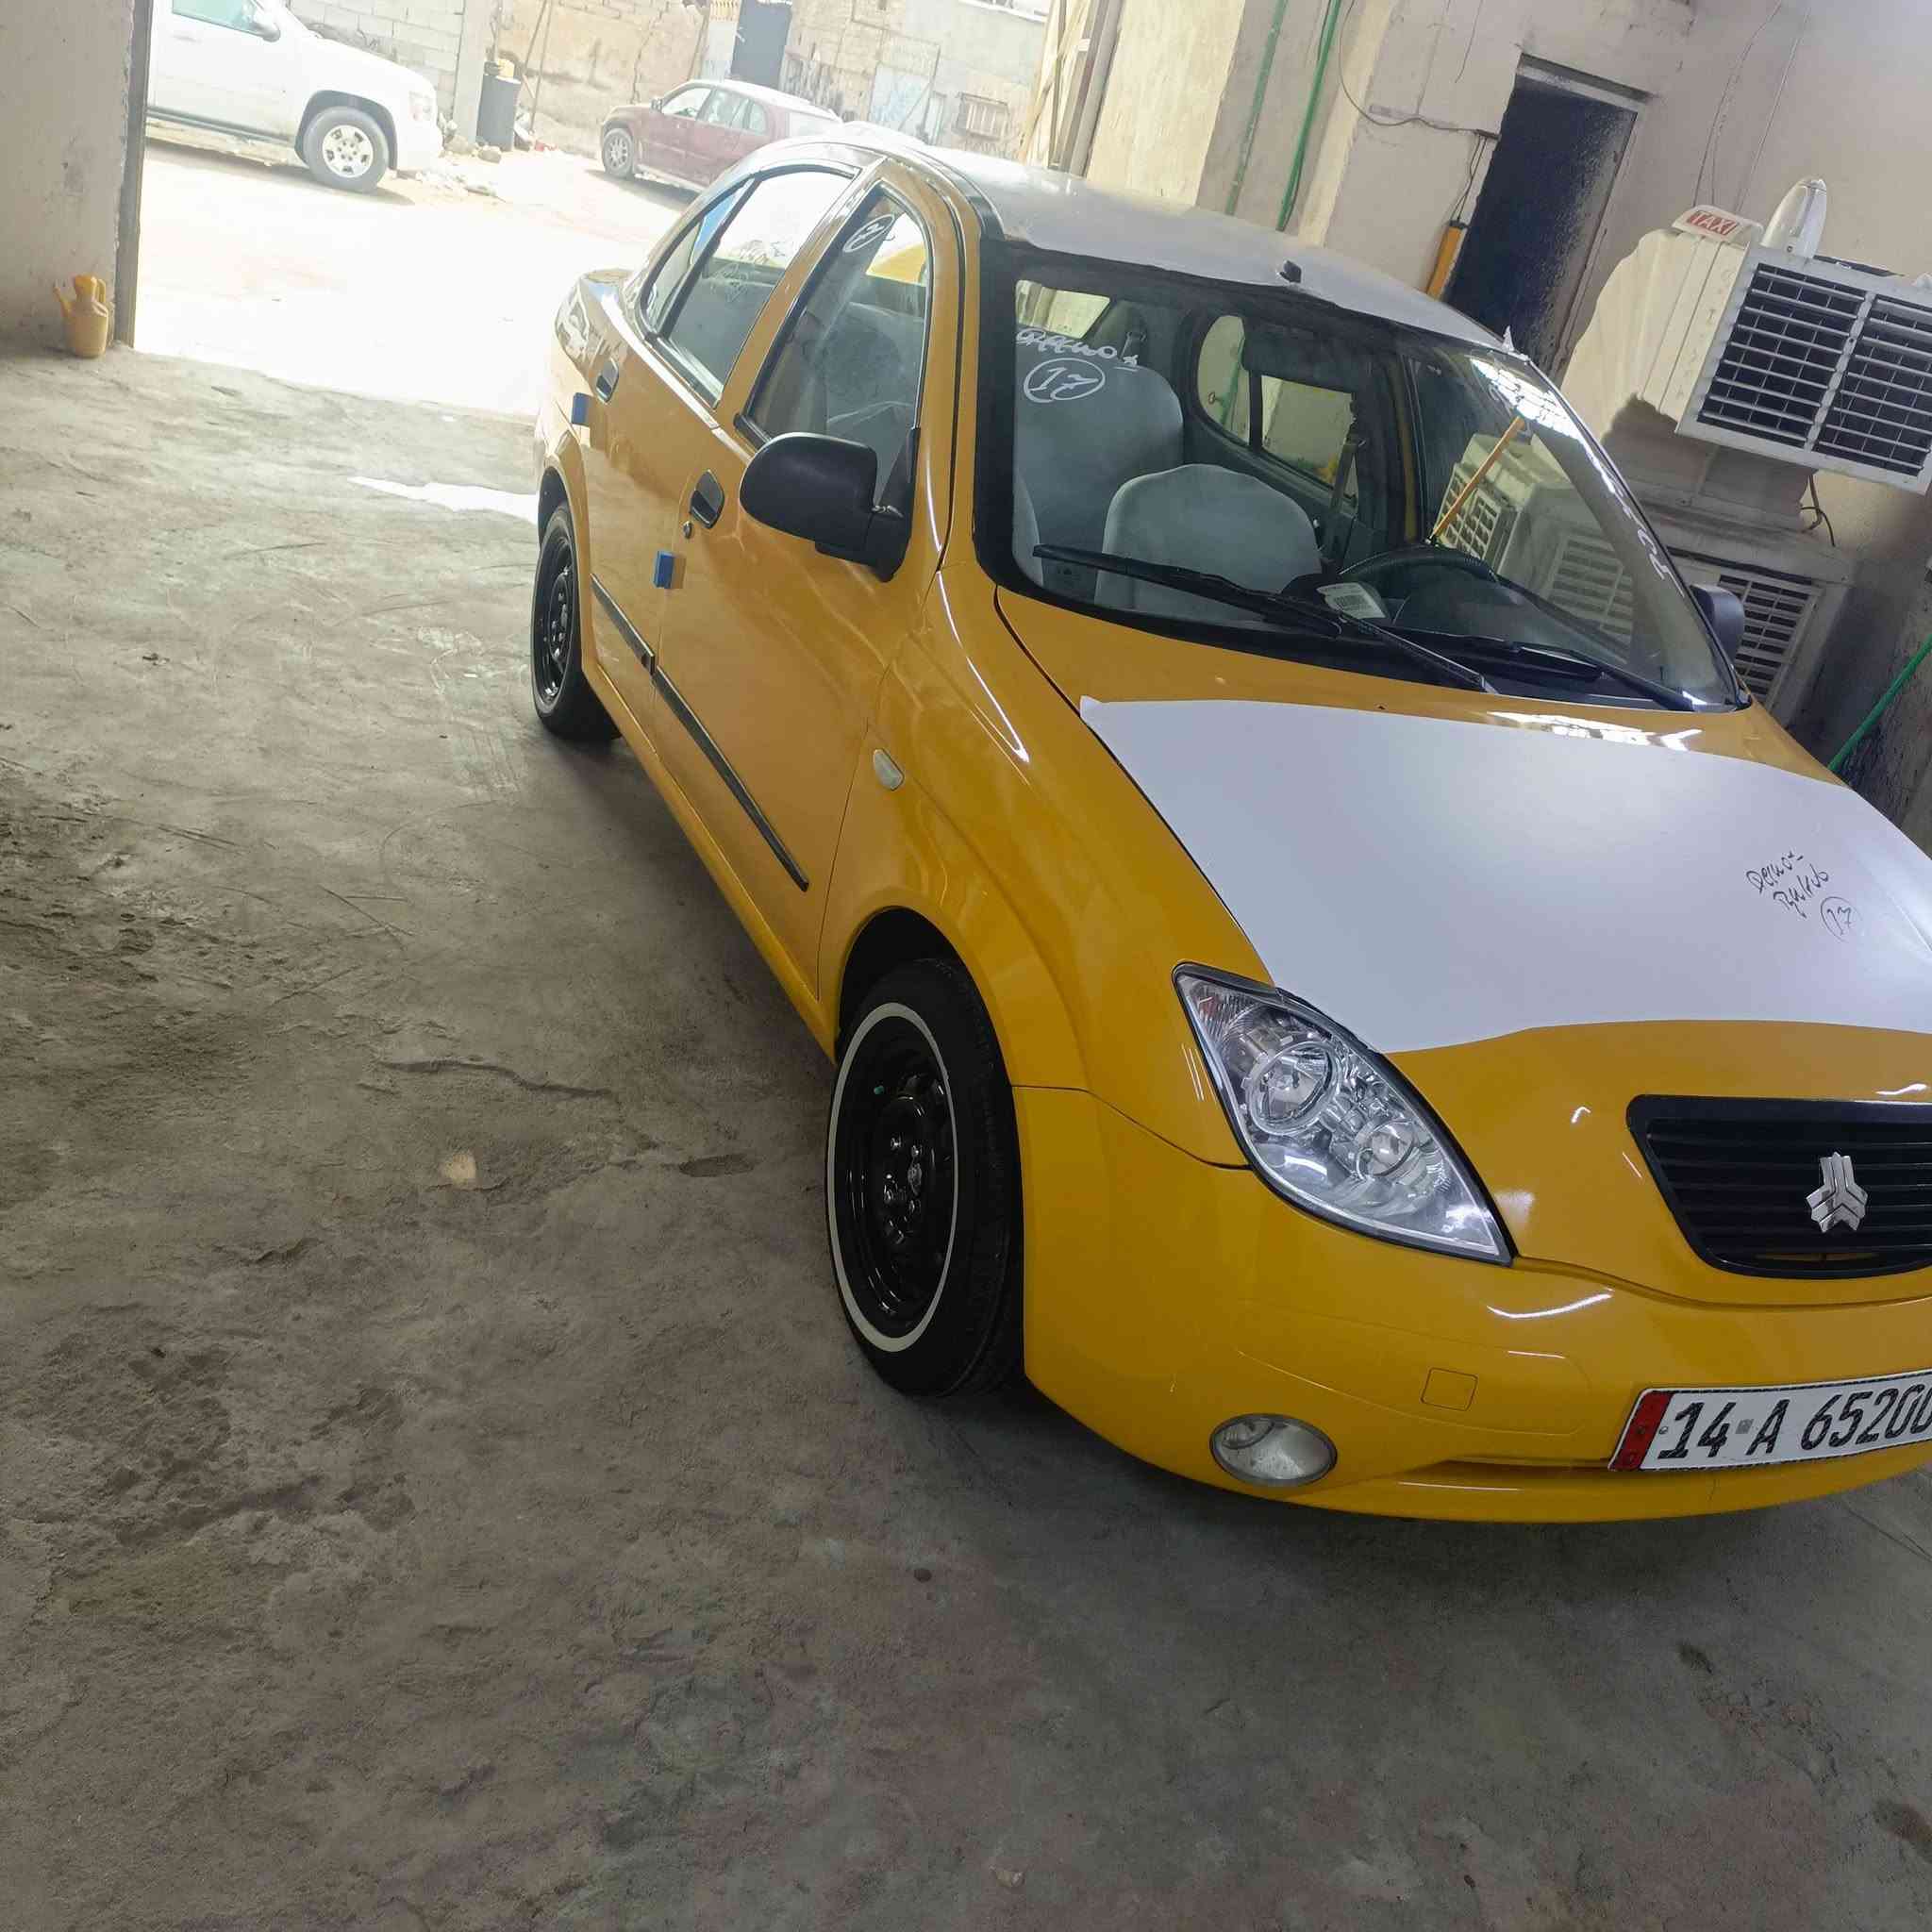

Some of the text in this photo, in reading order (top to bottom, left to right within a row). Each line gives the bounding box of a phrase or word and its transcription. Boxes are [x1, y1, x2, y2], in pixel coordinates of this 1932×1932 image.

[1689, 210, 1738, 236] TAXI
[1028, 364, 1102, 399] 17
[1657, 1401, 1737, 1459] 14
[1745, 1398, 1790, 1456] A
